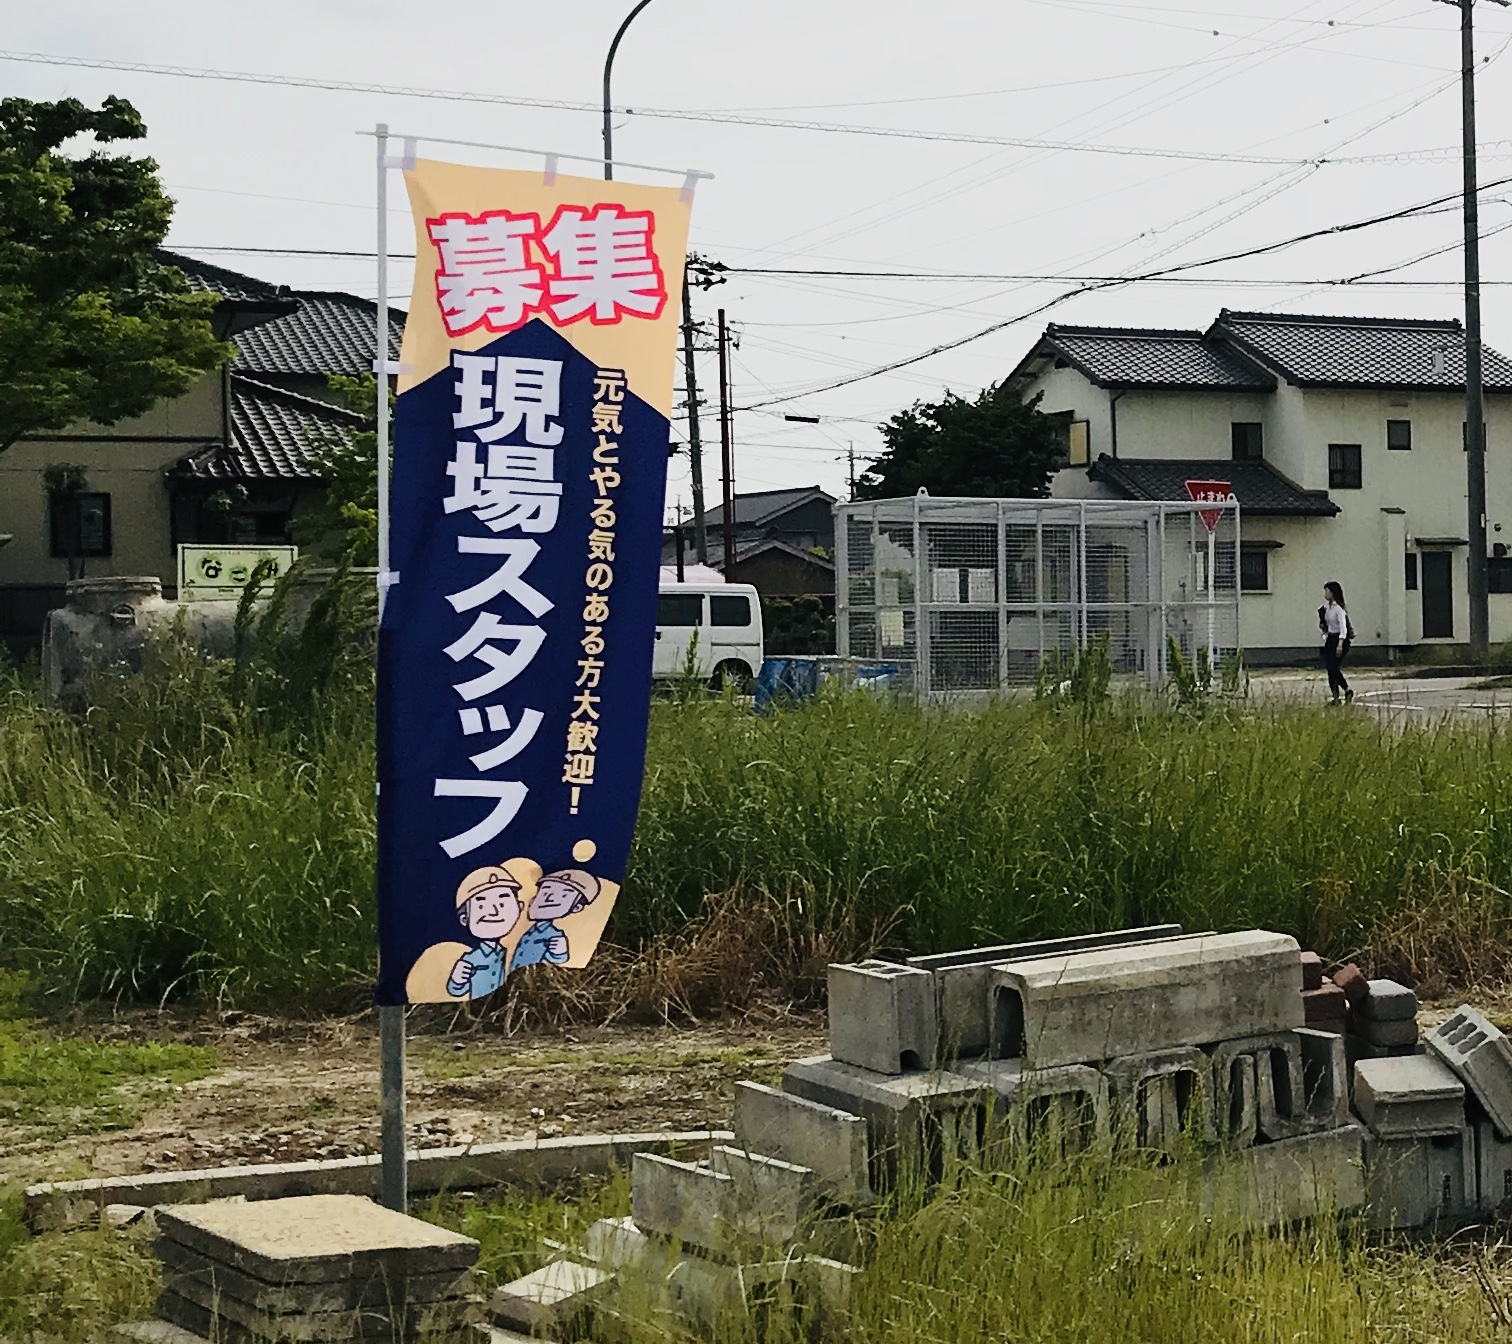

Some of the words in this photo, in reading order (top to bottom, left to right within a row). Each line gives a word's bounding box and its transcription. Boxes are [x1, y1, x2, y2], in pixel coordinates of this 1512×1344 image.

[427, 205, 667, 338] 募集
[434, 351, 564, 858] 現場スタッフ
[561, 368, 626, 816] 元気とやる気のある方大歓迎!
